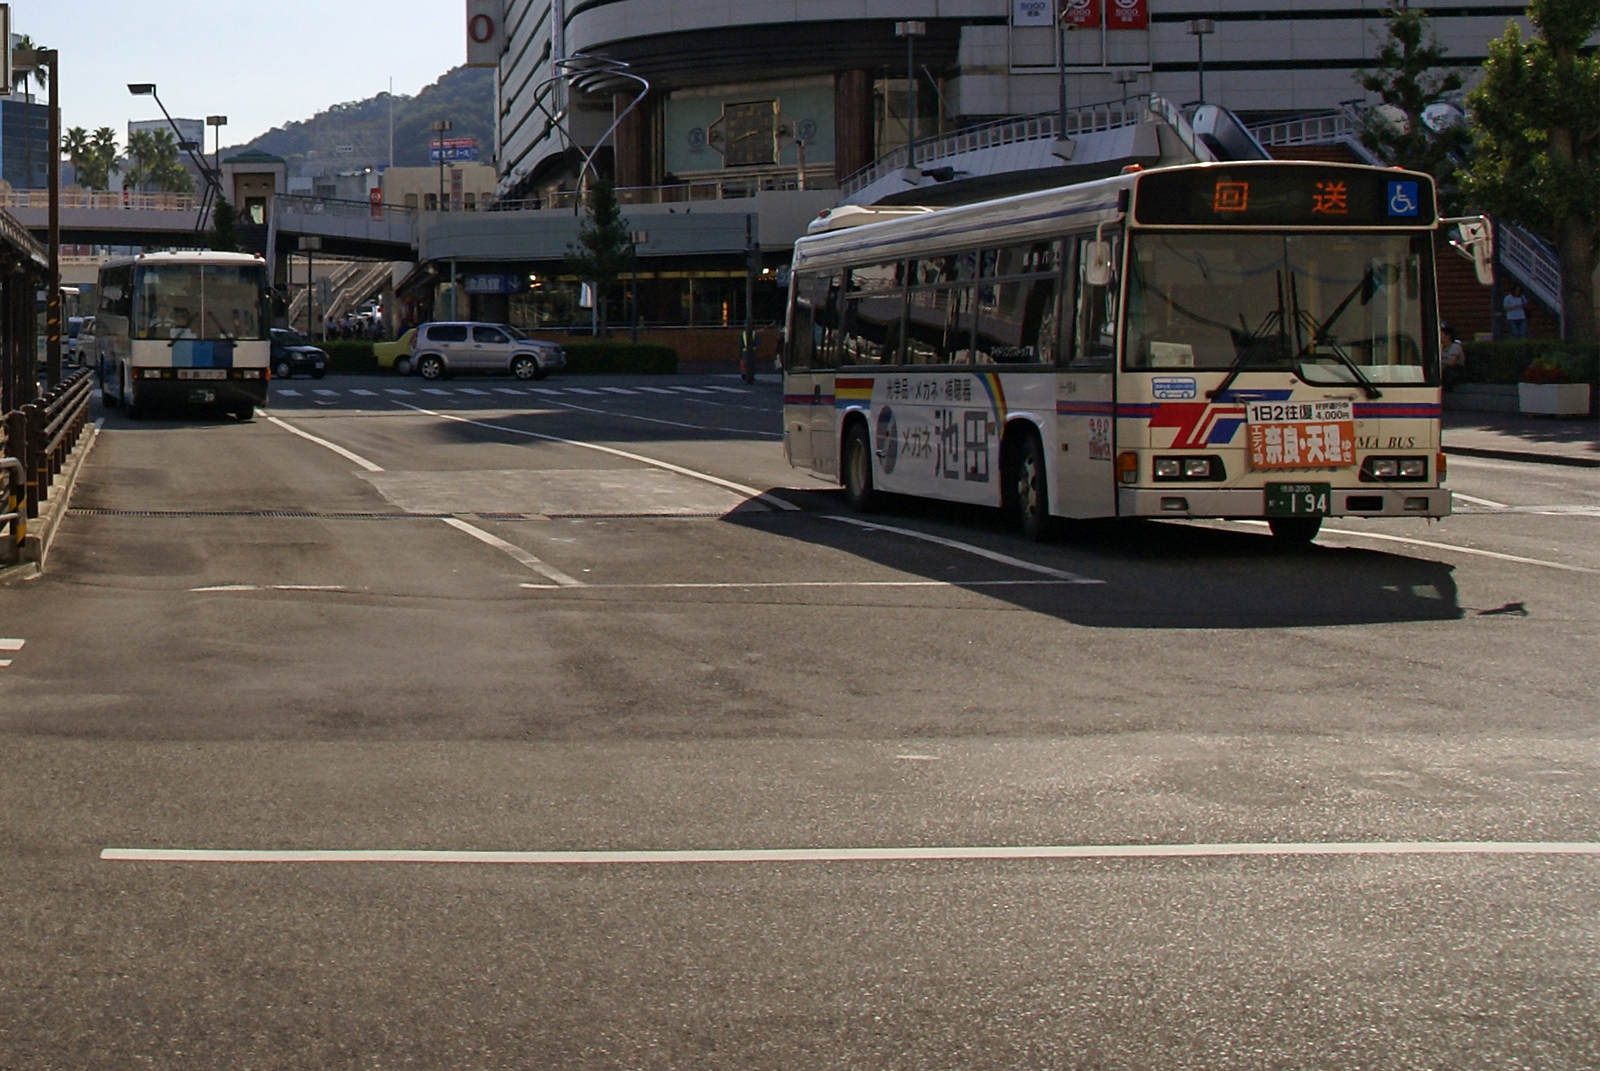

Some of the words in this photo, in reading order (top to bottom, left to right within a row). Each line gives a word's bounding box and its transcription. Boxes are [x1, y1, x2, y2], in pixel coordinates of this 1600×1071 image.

[1252, 404, 1313, 421] 1日2往復
[1315, 411, 1350, 422] 4,000円
[901, 428, 932, 459] メガネ
[935, 409, 990, 483] 池田
[1388, 436, 1415, 449] BUS
